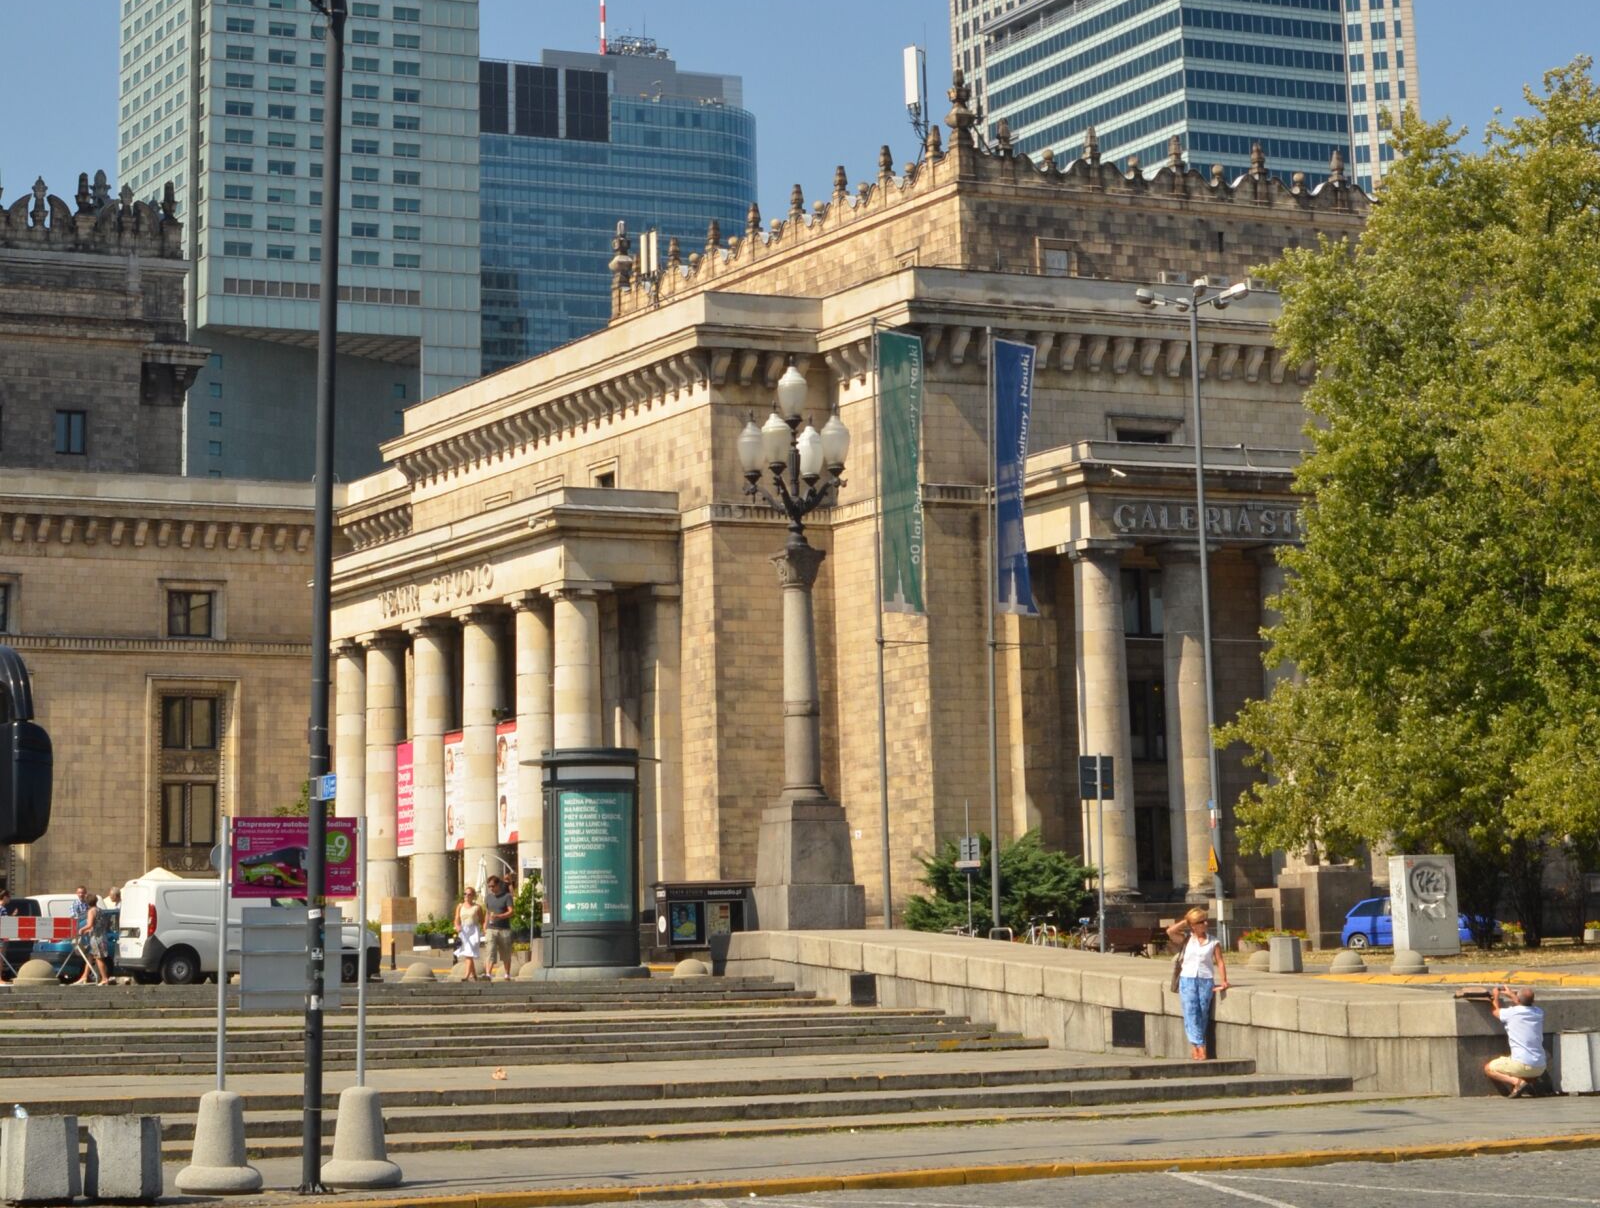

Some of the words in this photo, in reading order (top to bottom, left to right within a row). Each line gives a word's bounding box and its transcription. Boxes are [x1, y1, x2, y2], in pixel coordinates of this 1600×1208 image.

[908, 344, 919, 389] Nauki
[1019, 353, 1031, 398] Nauki
[1016, 412, 1030, 465] Kultury
[911, 518, 921, 540] lat
[1113, 503, 1252, 534] GALERIA
[1259, 509, 1298, 536] ST
[910, 545, 921, 565] 60
[377, 584, 421, 619] TEATR
[431, 563, 495, 603] STUDIO
[237, 821, 281, 829] Ekspresowy
[282, 820, 309, 828] autobu
[334, 835, 348, 857] 9
[576, 902, 589, 910] 750
[590, 902, 598, 910] M
